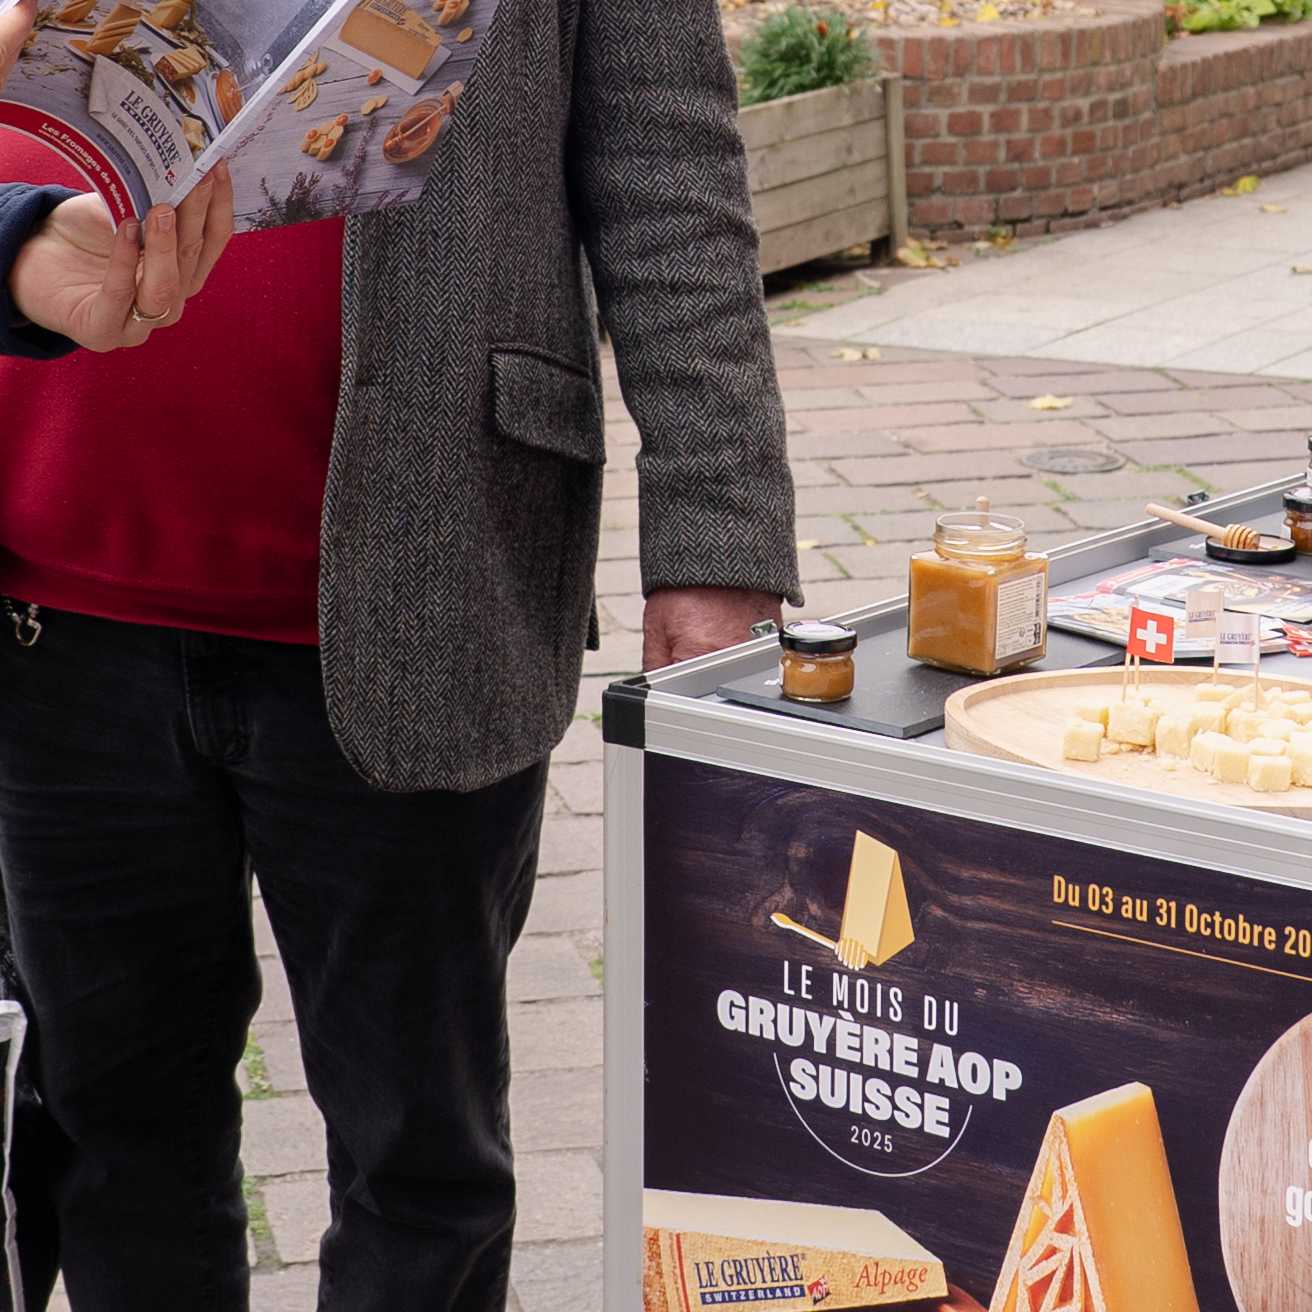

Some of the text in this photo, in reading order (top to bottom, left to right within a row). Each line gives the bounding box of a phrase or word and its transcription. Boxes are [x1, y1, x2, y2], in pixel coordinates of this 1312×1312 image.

[125, 90, 142, 109] LE
[140, 104, 181, 165] GRUYÈRE
[41, 122, 60, 136] Les
[60, 133, 101, 173] Fromages
[100, 171, 111, 184] de
[109, 182, 127, 218] Suisse.
[1053, 875, 1080, 907] Du
[1088, 883, 1114, 914] 03
[1120, 895, 1148, 922] au
[1155, 898, 1177, 928] 31
[1184, 903, 1276, 950] Octobre
[783, 960, 959, 1036] LE MOIS DU
[716, 989, 1024, 1102] GRUYÈRE AOP
[789, 1057, 950, 1138] SUISSE
[850, 1125, 894, 1153] 2025
[694, 1250, 804, 1288] LE GRUYÈRE
[703, 1285, 802, 1304] SWITZERLAND
[855, 1261, 929, 1296] Alpage
